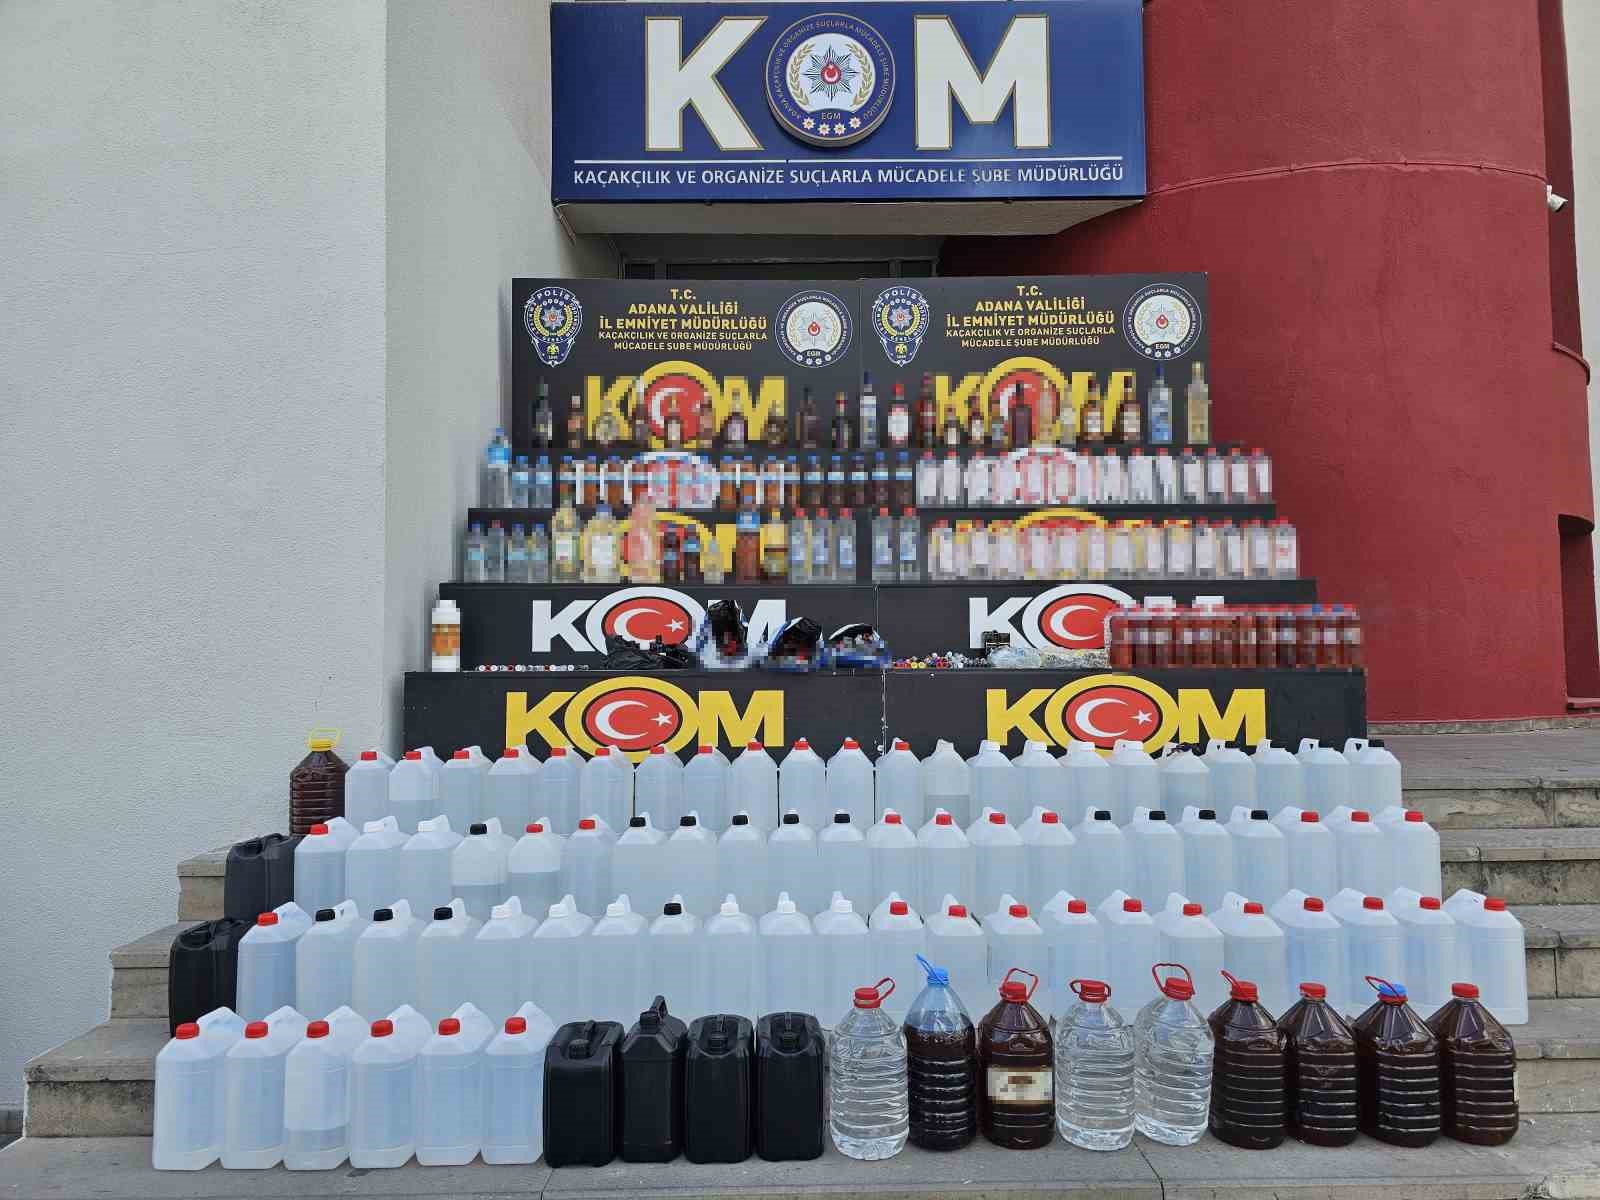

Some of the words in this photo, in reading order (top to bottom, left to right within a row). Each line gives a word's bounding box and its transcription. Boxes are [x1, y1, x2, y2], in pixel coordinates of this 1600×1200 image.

[821, 112, 841, 120] EGM
[573, 170, 671, 187] KAÇAKÇILIK
[677, 170, 697, 184] VE
[702, 167, 784, 184] ORGANİZE
[789, 169, 873, 187] SUÇLARLA
[878, 166, 966, 183] MÜCADELE
[972, 168, 1011, 184] ŞUBE
[1018, 164, 1123, 182] MÜDÜRLÜĞÜ
[669, 288, 697, 300] T.C.
[1015, 285, 1043, 297] T.C.
[629, 303, 677, 315] ADANA
[680, 301, 739, 315] VALİLİĞİ
[975, 300, 1023, 312] ADANA
[1026, 297, 1085, 311] VALİLİĞİ
[599, 315, 612, 329] İL
[616, 315, 677, 330] EMNİYET
[681, 315, 767, 330] MÜDÜRLÜĞÜ
[946, 313, 959, 327] İL
[963, 312, 1024, 327] EMNİYET
[1028, 310, 1115, 326] MÜDÜRLÜĞÜ
[599, 331, 655, 341] KAÇAKÇILIK
[657, 331, 669, 340] VE
[670, 330, 717, 340] ORGANİZE
[946, 328, 1002, 338] KAÇAKÇILIK
[1004, 328, 1015, 337] VE
[1018, 327, 1064, 336] ORGANİZE
[1066, 327, 1115, 337] SUÇLARLA
[961, 338, 1012, 347] MÜCADELE
[1014, 339, 1039, 349] ŞUBE
[1042, 336, 1100, 346] MÜDÜRLÜĞÜ
[505, 676, 785, 763] KOM
[986, 673, 1267, 758] KOM
